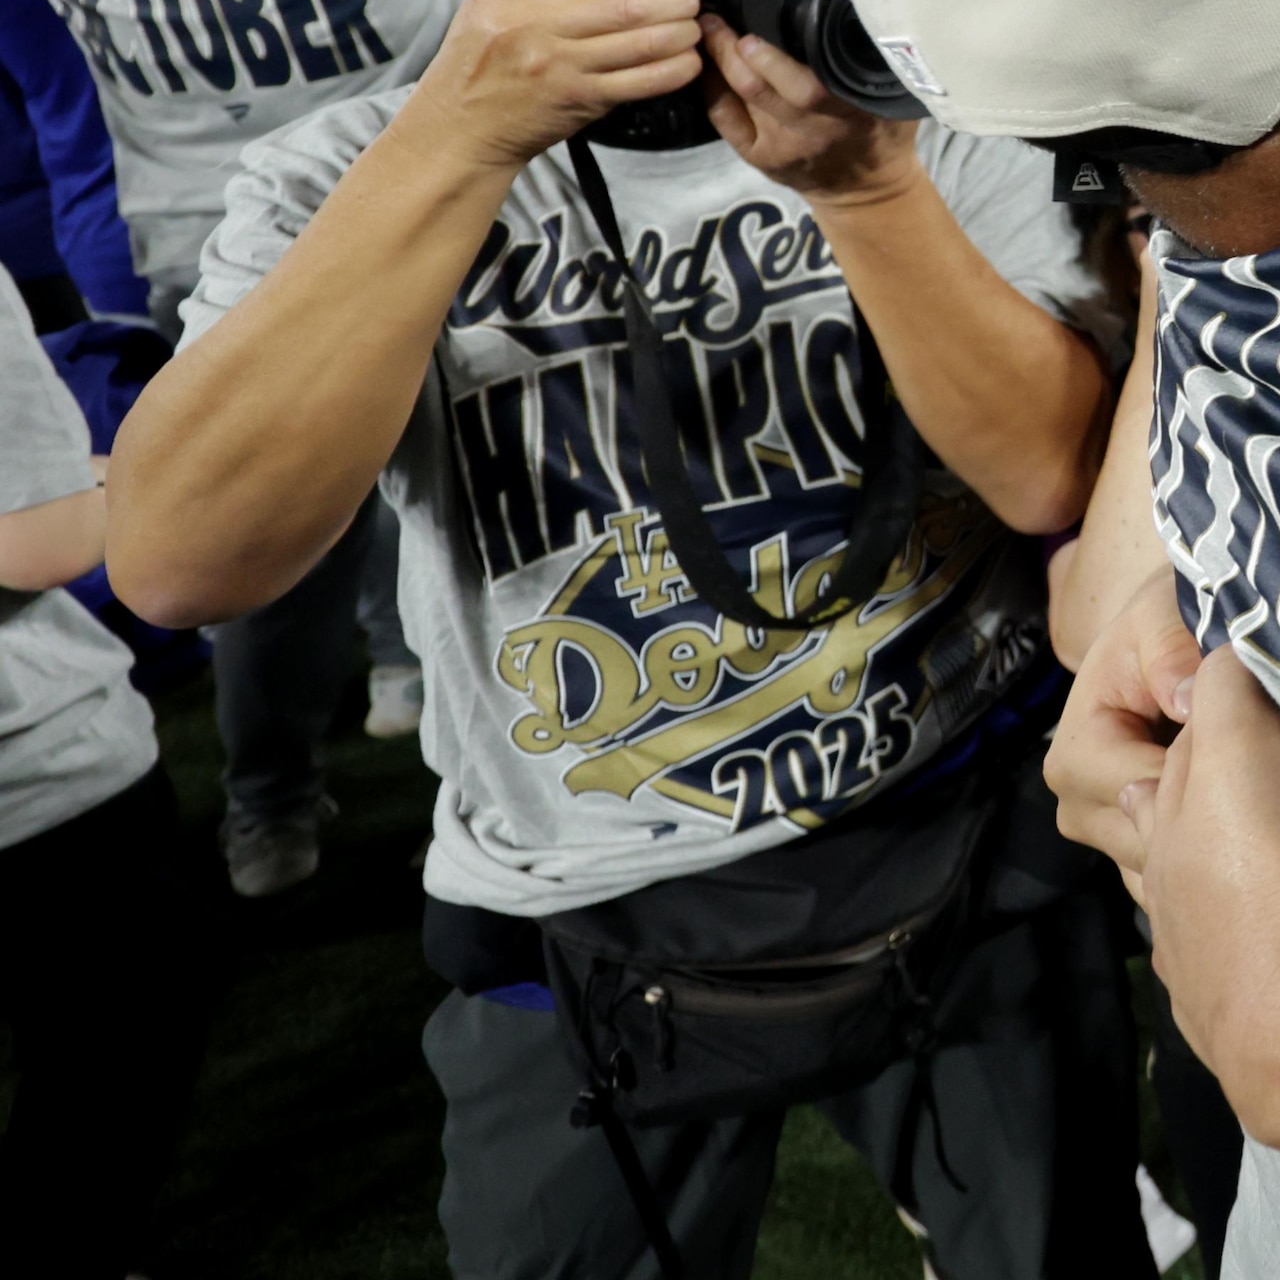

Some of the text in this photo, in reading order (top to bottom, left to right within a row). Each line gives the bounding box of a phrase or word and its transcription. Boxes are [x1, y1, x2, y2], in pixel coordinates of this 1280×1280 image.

[447, 197, 835, 352] World Ser
[450, 316, 868, 592] HAMPIO
[710, 682, 920, 834] 2025
